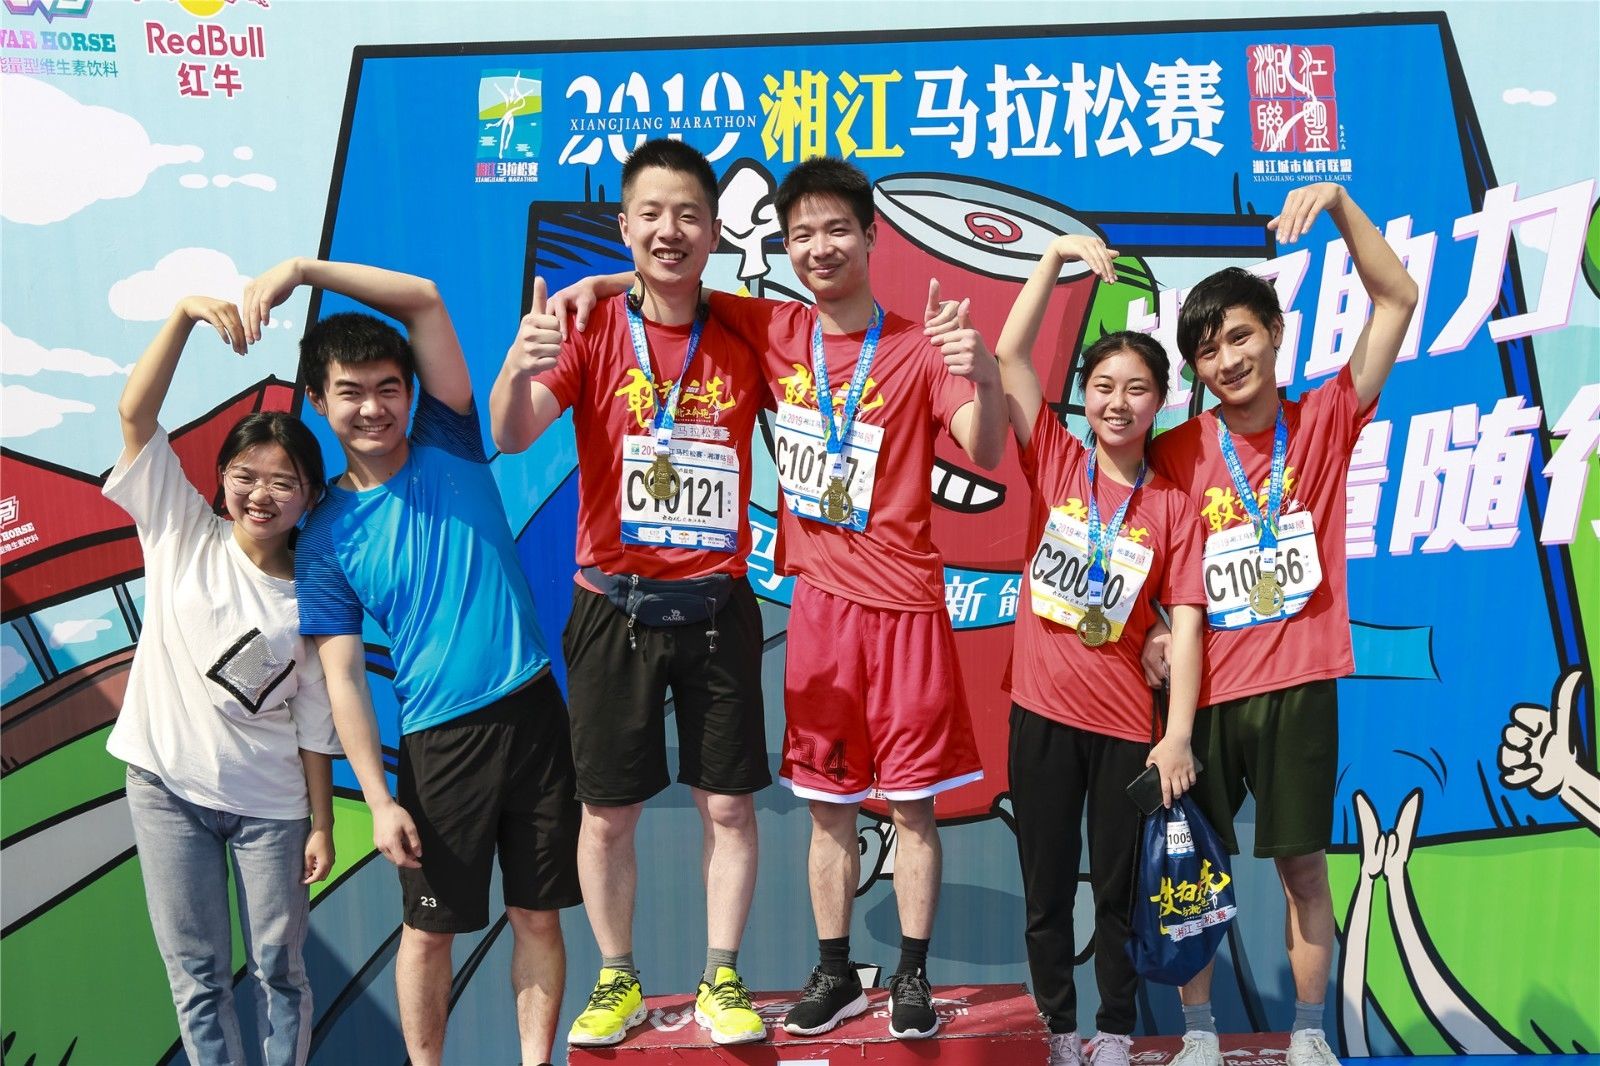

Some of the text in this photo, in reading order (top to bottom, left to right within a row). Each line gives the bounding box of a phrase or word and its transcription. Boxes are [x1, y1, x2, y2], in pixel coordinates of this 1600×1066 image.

[40, 31, 116, 52] HORSE
[145, 21, 265, 58] RedBull
[178, 62, 242, 98] 红牛
[569, 115, 757, 133] XIANGJIANG MARATHON
[758, 57, 1226, 163] 湘江马拉松赛
[1296, 174, 1323, 182] SPORTS
[777, 435, 859, 492] C1017
[420, 896, 437, 908] 23
